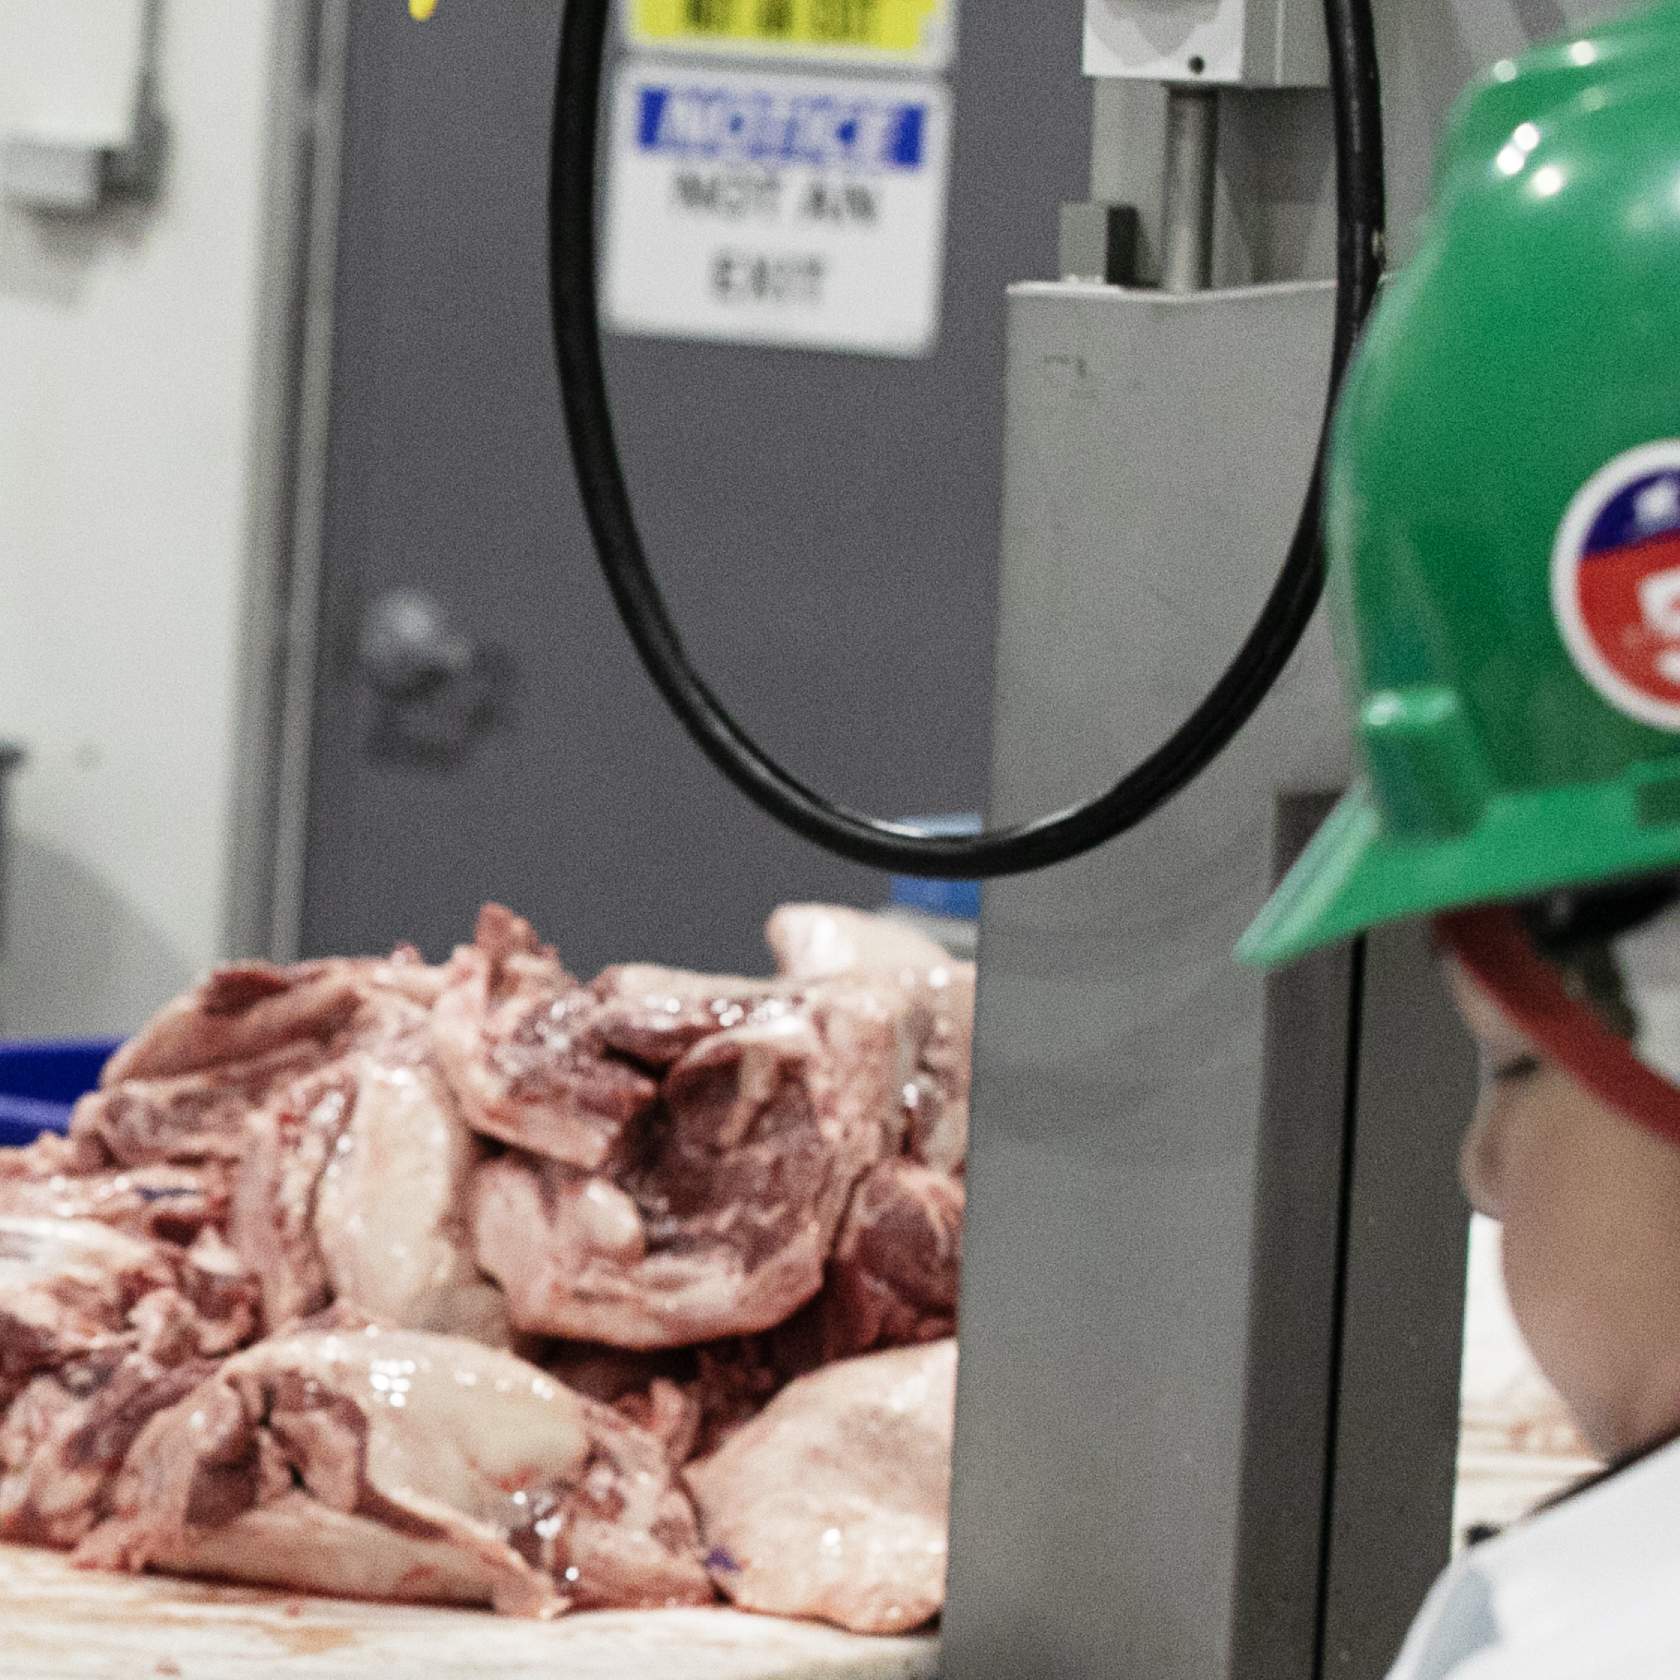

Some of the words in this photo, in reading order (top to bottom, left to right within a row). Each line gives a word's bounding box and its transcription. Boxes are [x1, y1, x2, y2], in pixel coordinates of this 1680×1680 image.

[662, 92, 898, 166] NOTICE
[672, 168, 785, 220] NOT
[800, 180, 880, 228] AN
[709, 250, 826, 304] EXIT
